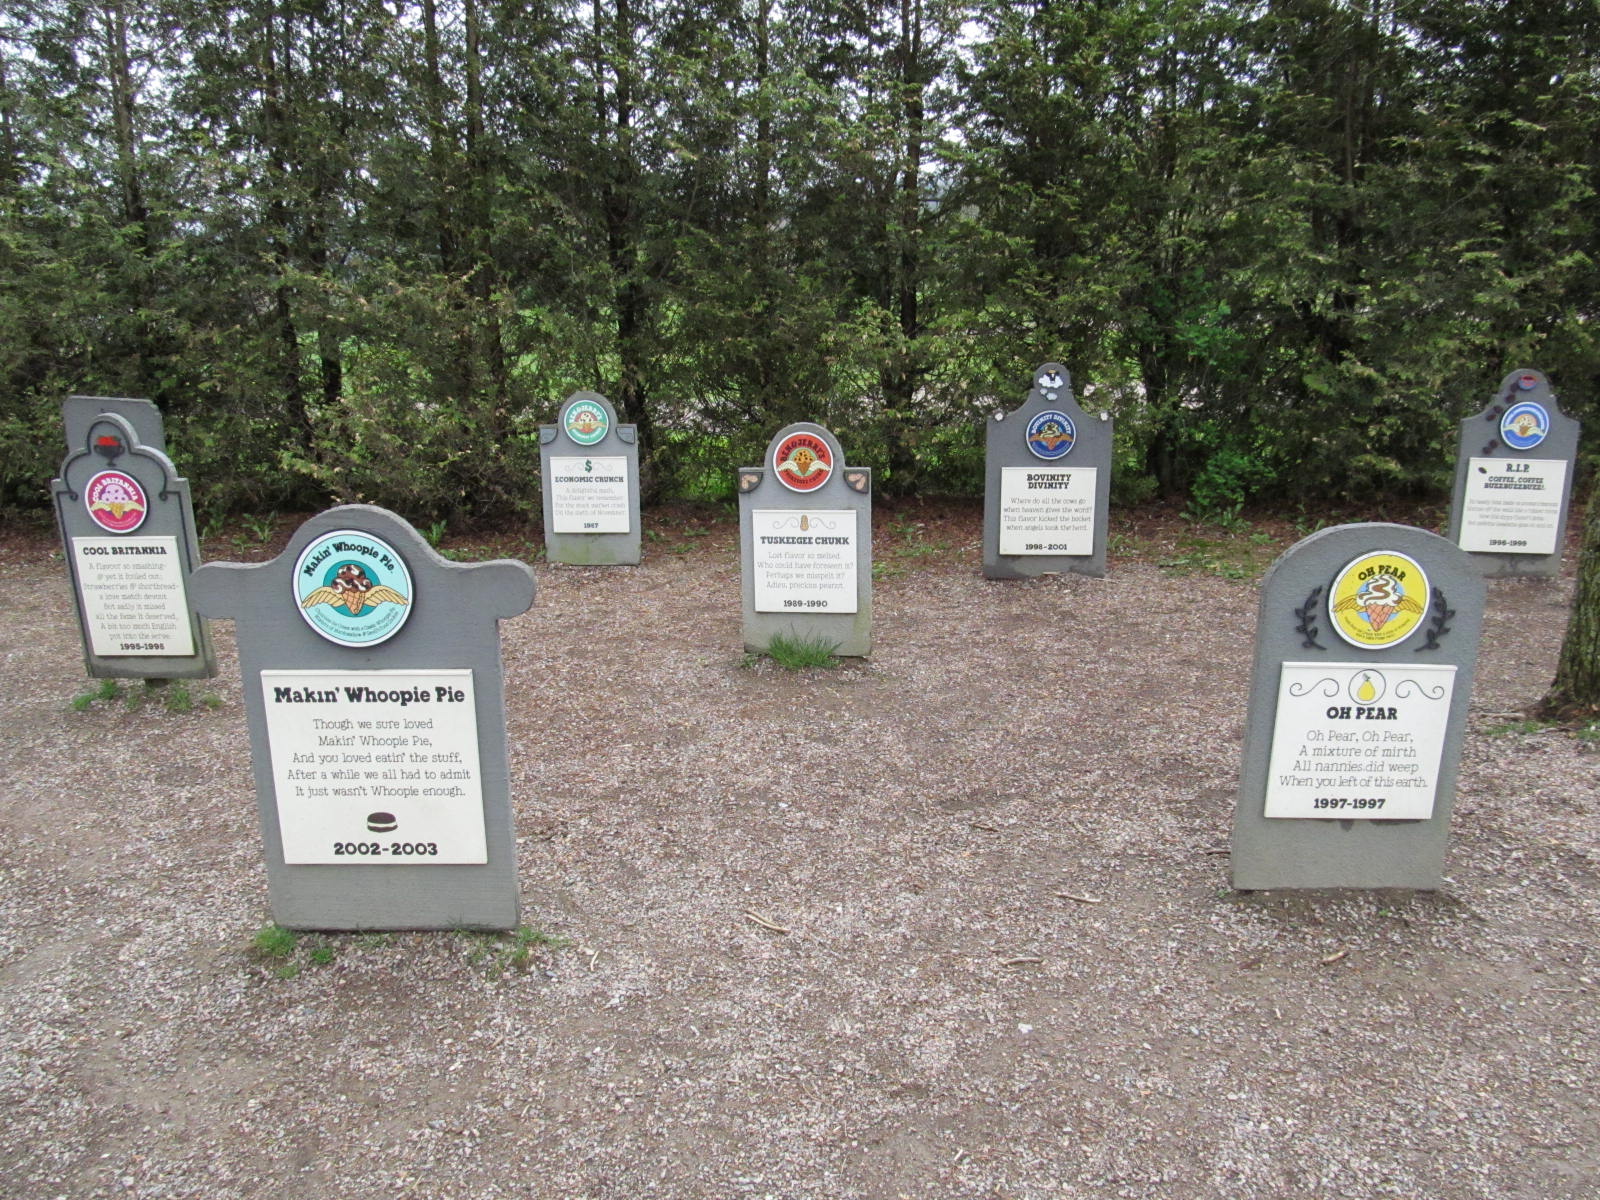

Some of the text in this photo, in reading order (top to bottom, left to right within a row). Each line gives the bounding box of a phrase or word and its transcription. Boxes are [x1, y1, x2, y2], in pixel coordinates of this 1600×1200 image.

[112, 547, 167, 555] BRITANNIA
[304, 546, 332, 577] Makin'
[333, 542, 379, 558] Whoopie
[1358, 565, 1406, 581] OH PEAR
[274, 687, 465, 706] Makin' Whoopie Pie
[1326, 707, 1397, 720] OH PEAR
[313, 719, 353, 730] Though
[376, 720, 400, 729] sure
[404, 719, 433, 729] loved
[318, 736, 432, 748] Makin' Whoopie Pie,
[1306, 730, 1413, 743] Oh Pear, Oh Pear,
[1299, 746, 1416, 758] A mixture of mirth
[293, 753, 314, 763] And
[319, 755, 338, 765] you
[343, 753, 372, 763] loved
[409, 753, 428, 763] the
[432, 752, 462, 764] stuff,
[1293, 760, 1419, 774] All nannies did weep
[288, 769, 317, 780] After
[331, 769, 360, 780] while
[364, 772, 378, 780] we
[382, 769, 397, 780] all
[401, 769, 420, 780] had
[425, 770, 436, 780] to
[440, 769, 470, 780] admit
[1280, 776, 1427, 788] When you left of this earth.
[296, 786, 465, 798] It just wasn't Whoopie enough.
[1314, 798, 1385, 809] 1997-1997
[334, 842, 438, 855] 2002-2003
